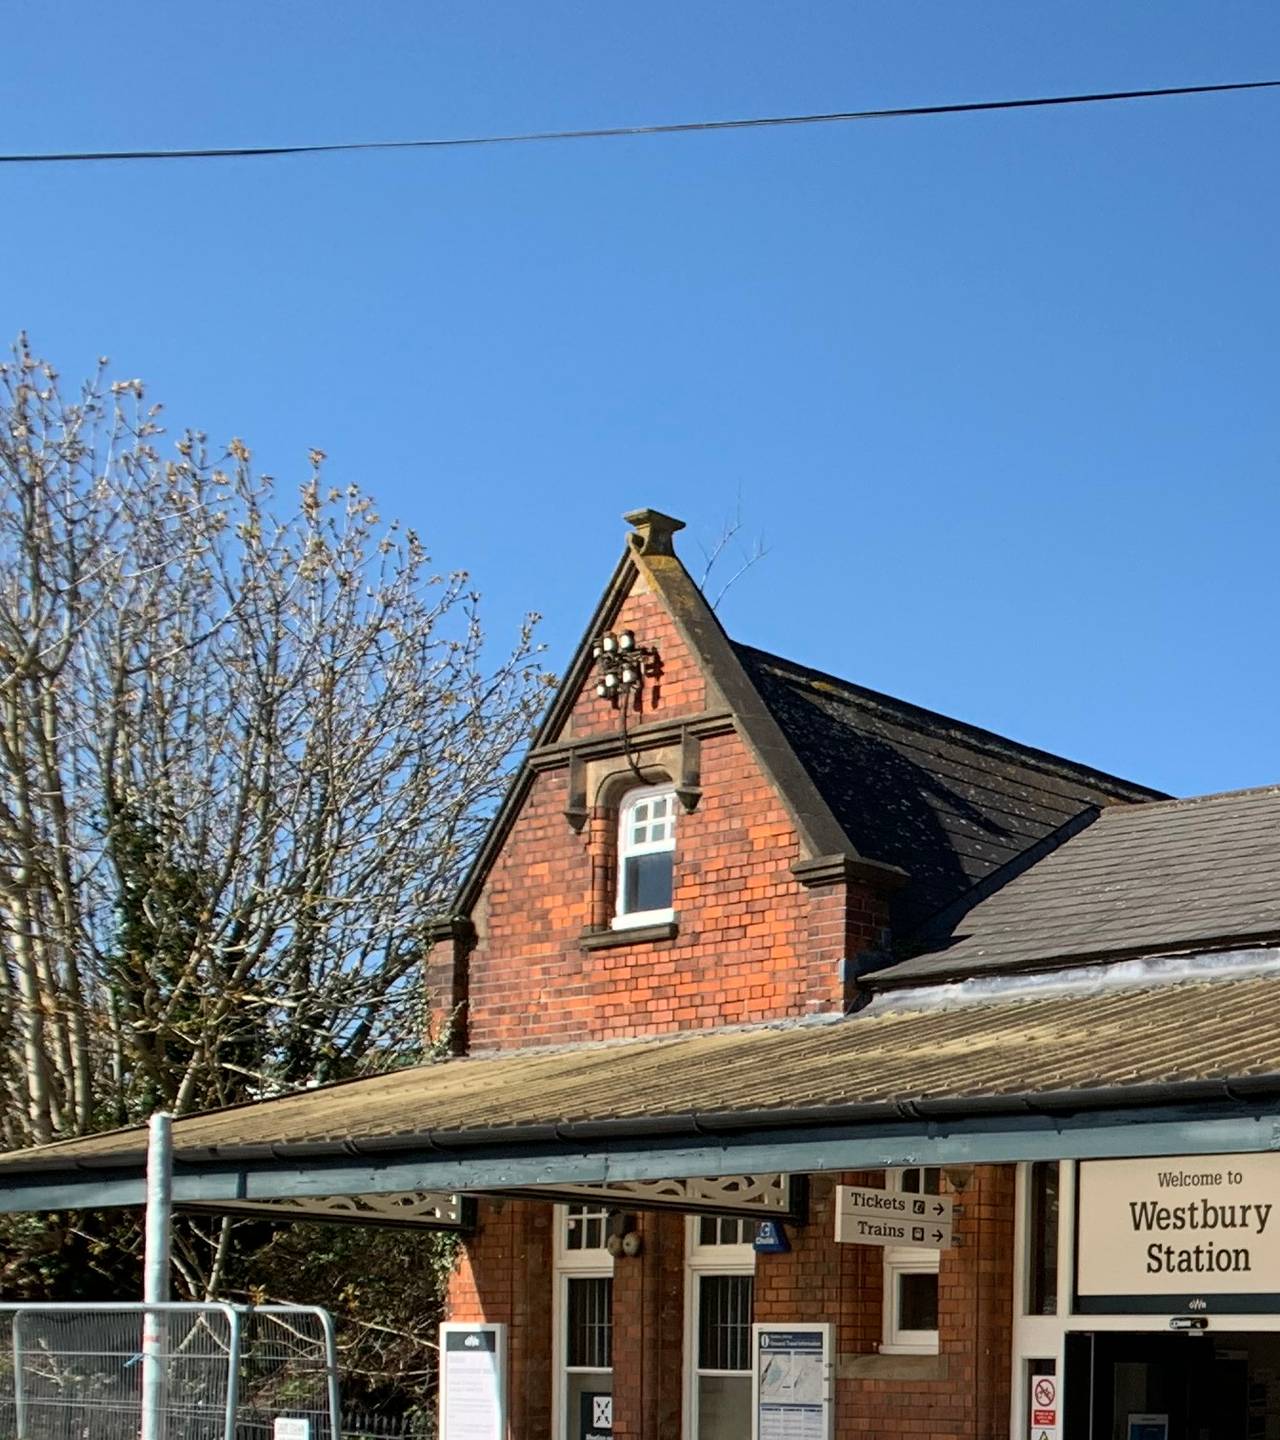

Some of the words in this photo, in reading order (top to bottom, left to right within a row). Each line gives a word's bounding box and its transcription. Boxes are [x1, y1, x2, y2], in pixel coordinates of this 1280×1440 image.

[1158, 1171, 1222, 1188] Welcome
[1228, 1171, 1243, 1185] to
[851, 1192, 905, 1211] Tickets
[1129, 1199, 1272, 1234] Westbury
[857, 1221, 905, 1238] Trains
[1147, 1241, 1251, 1273] Station
